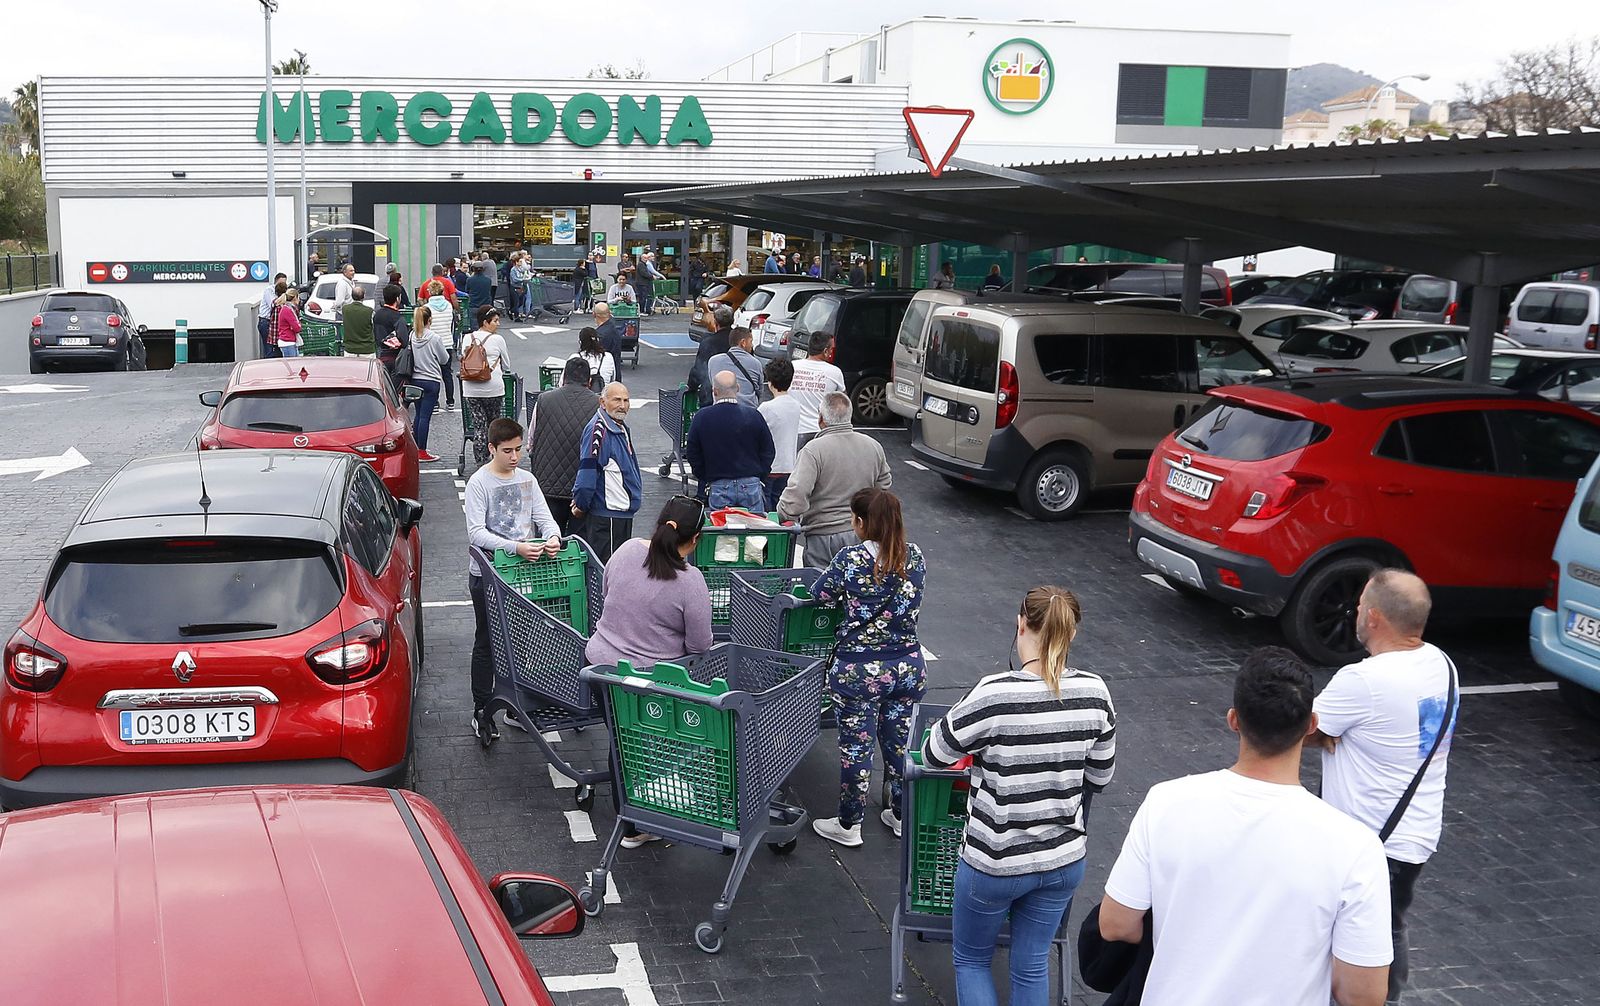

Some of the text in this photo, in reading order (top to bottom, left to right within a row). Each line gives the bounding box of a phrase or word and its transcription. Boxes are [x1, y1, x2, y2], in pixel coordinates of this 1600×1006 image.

[255, 90, 713, 147] MERCADONA
[132, 263, 226, 272] PARKING CLIENTES
[153, 272, 206, 280] MERCADONA
[1173, 473, 1192, 490] 6038
[137, 711, 250, 736] 0308 KTS
[155, 737, 190, 745] TAHERMO
